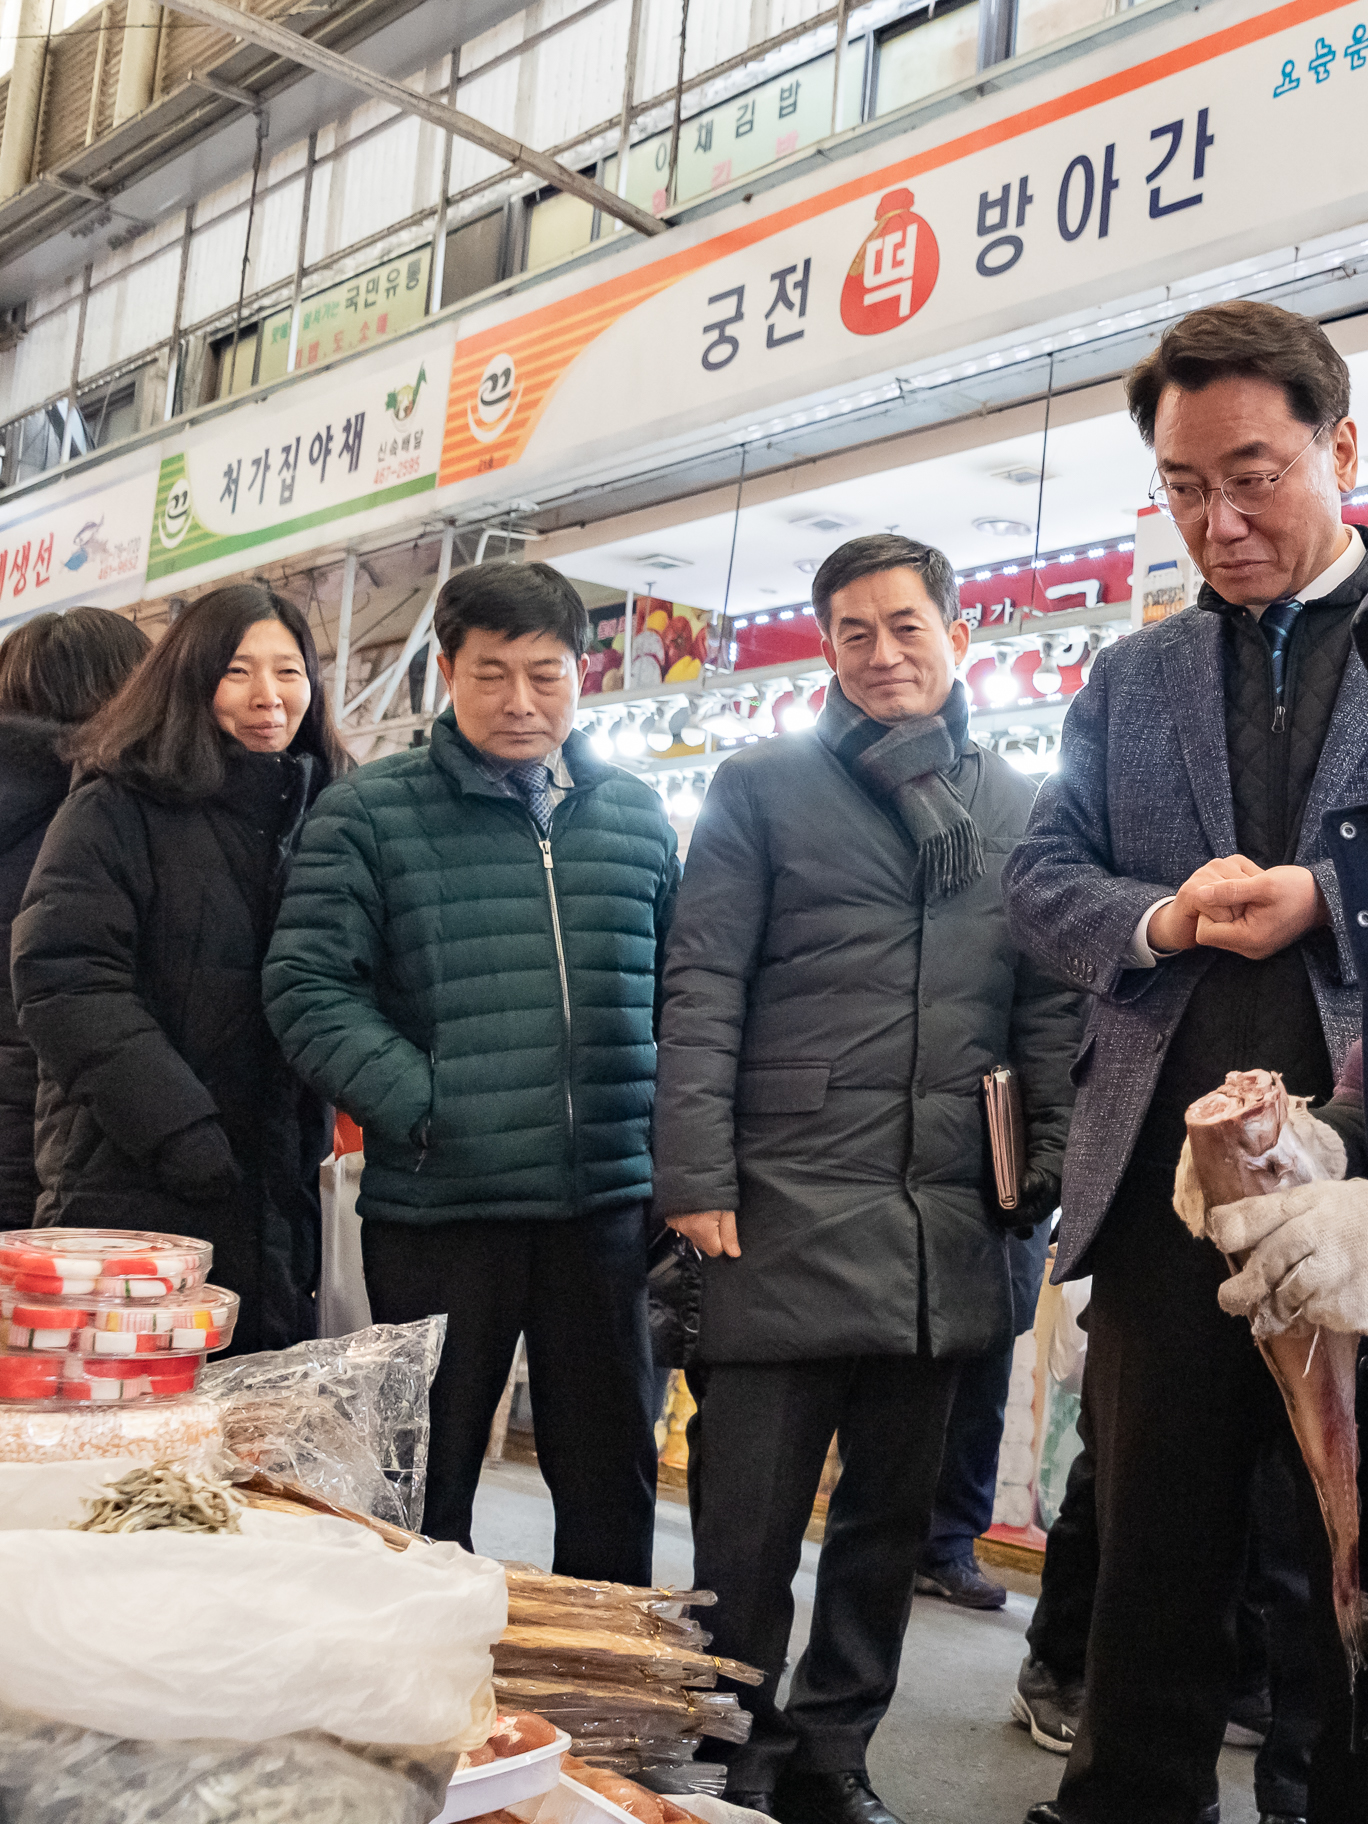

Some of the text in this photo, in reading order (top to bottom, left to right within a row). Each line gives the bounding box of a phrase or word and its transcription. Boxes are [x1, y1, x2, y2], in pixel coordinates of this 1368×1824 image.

[701, 107, 1214, 372] 궁전 떡 방아간
[0, 532, 54, 600] 생선
